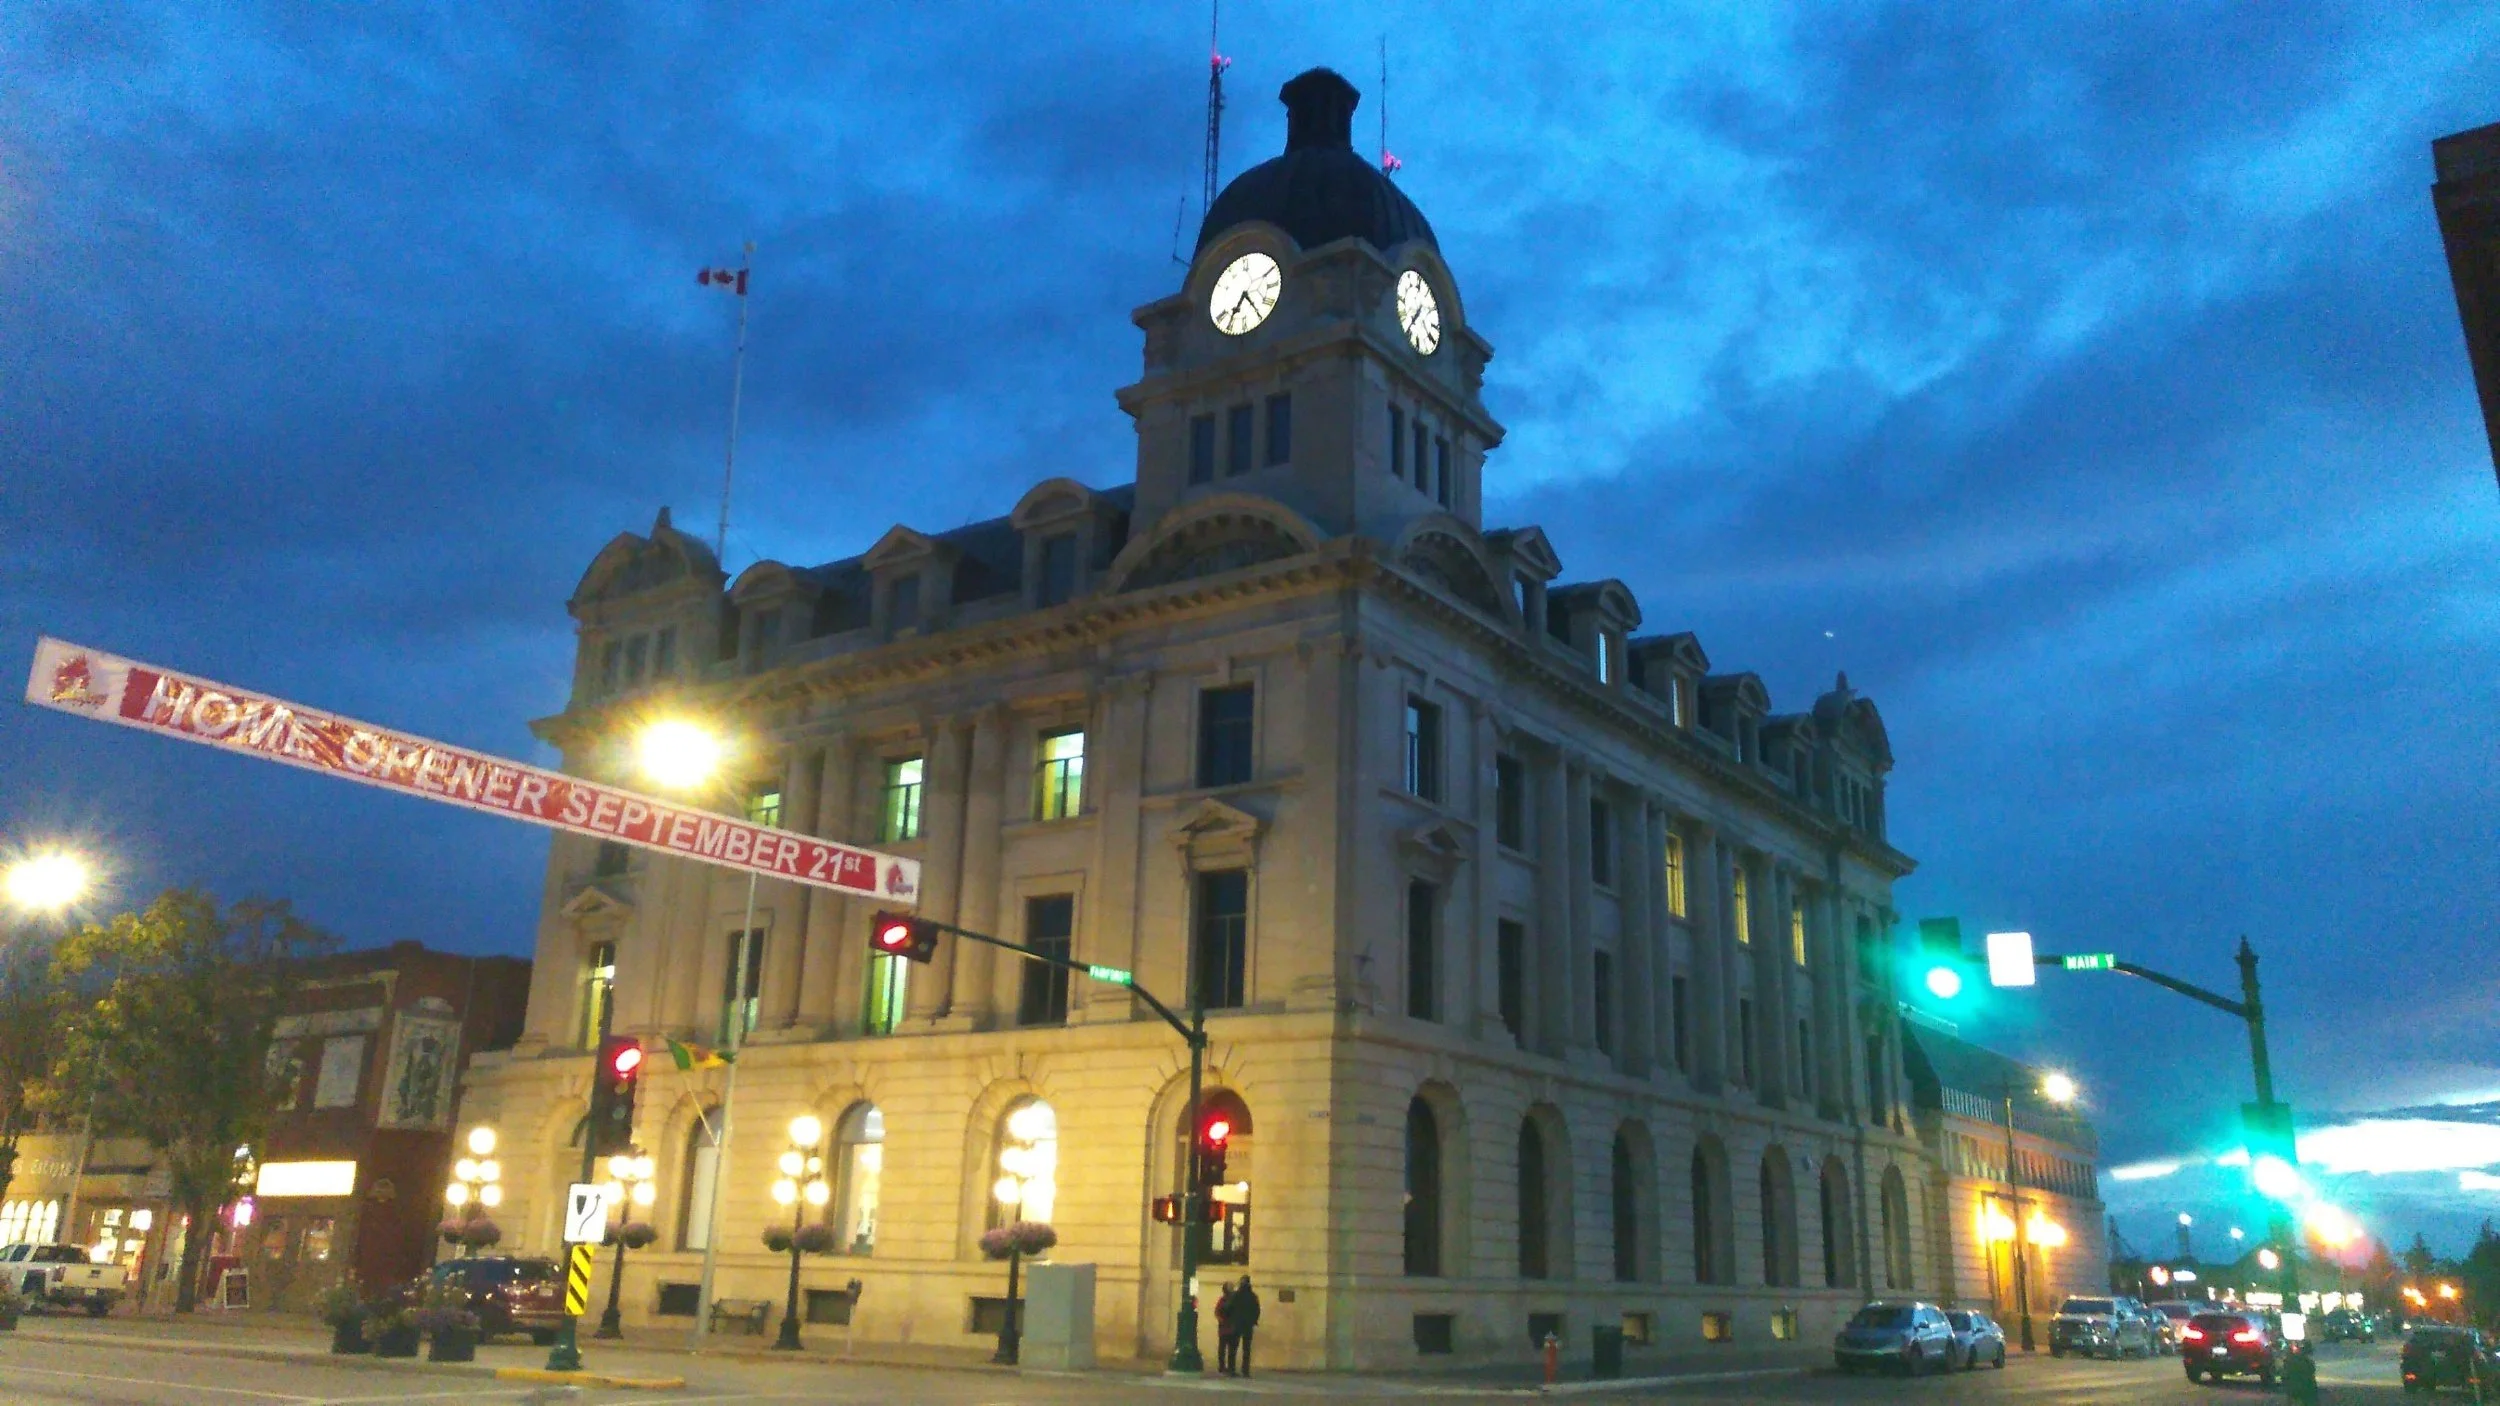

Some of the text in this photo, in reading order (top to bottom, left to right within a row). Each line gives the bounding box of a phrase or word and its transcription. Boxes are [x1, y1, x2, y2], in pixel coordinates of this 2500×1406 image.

[142, 675, 861, 882] HOME OPENER SEPTEMBER 21st
[2067, 955, 2098, 970] MAIN
